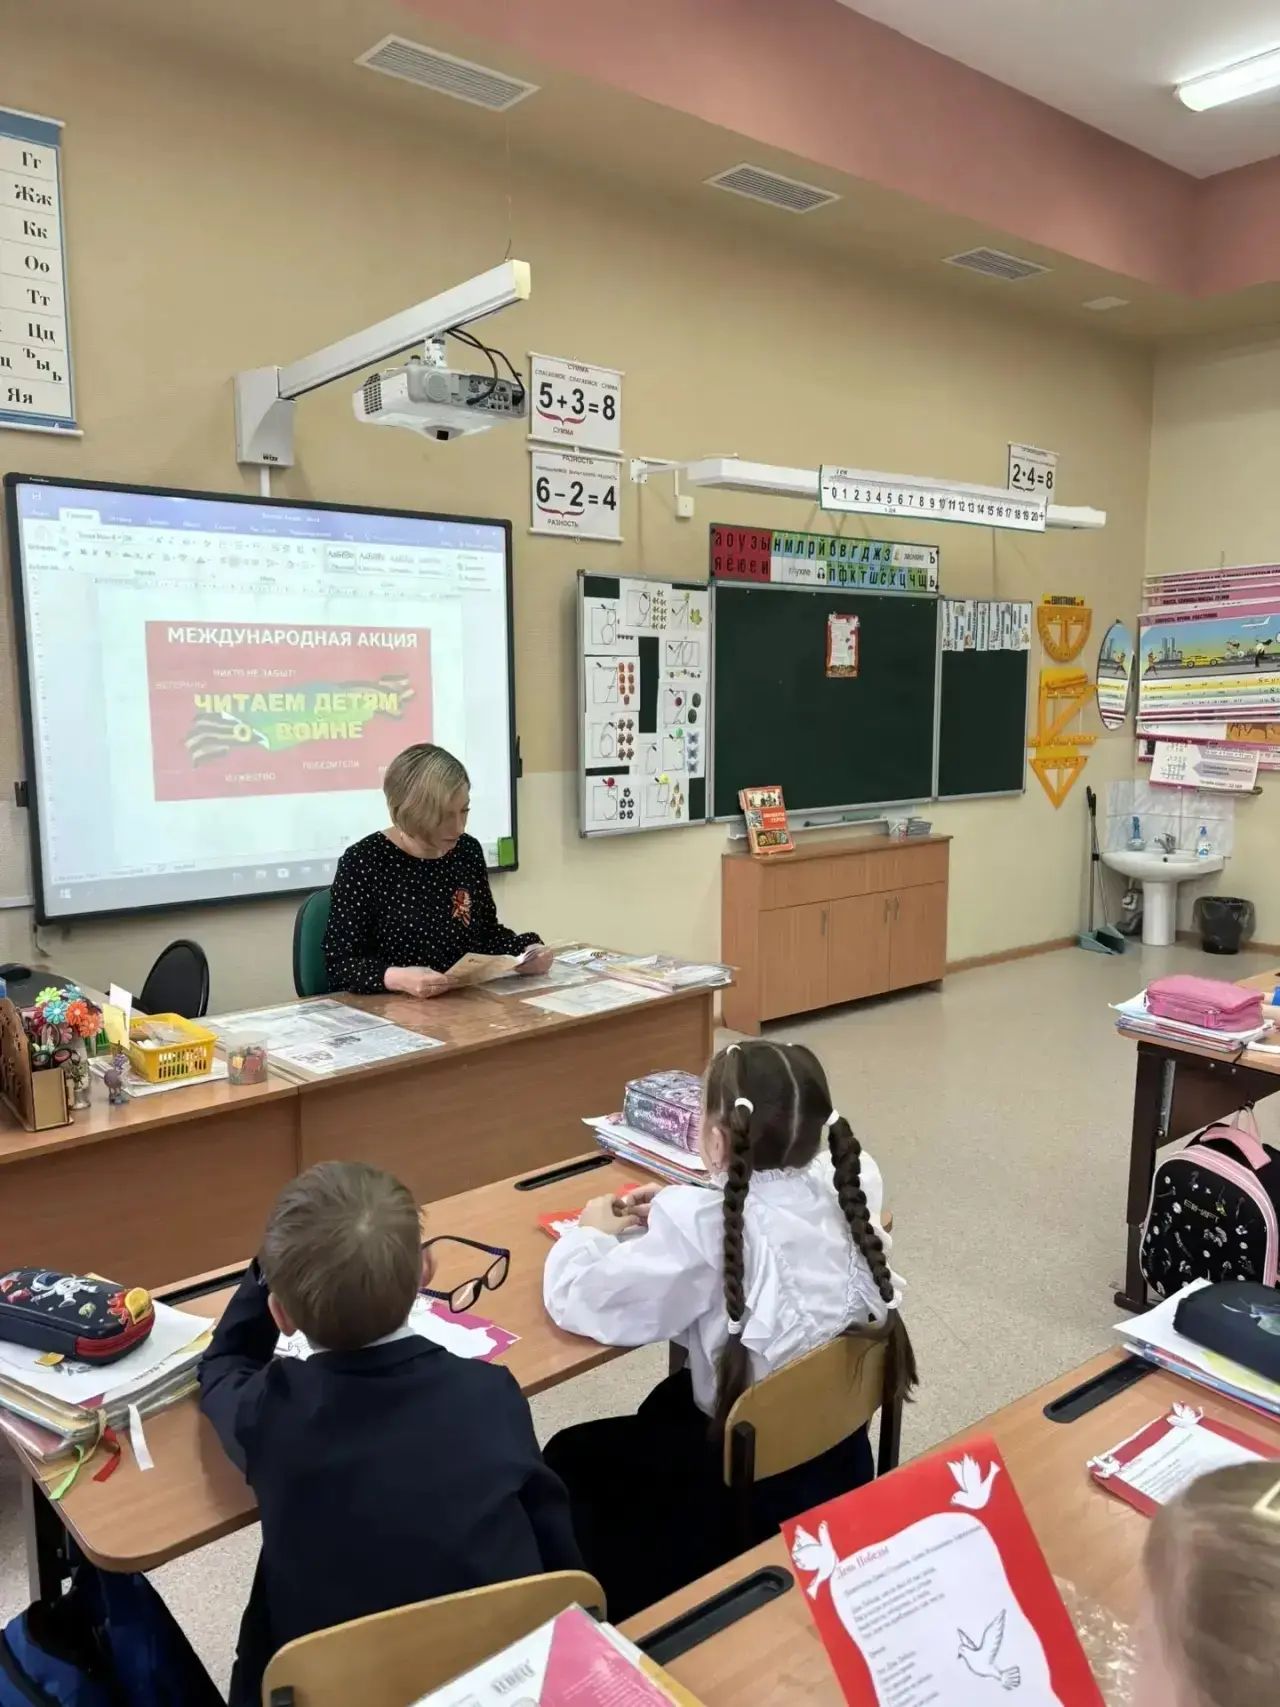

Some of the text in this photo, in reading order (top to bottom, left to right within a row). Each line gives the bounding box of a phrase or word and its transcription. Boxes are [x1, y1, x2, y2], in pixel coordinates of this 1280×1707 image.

[22, 151, 41, 169] Гг
[14, 184, 52, 206] Жж
[23, 220, 48, 239] Кк
[24, 255, 50, 273] Оо
[27, 288, 50, 308] Тт
[28, 323, 55, 344] Цц
[7, 387, 33, 404] Яя
[553, 426, 574, 436] СУММА
[854, 489, 860, 501] 2
[866, 490, 871, 502] 3
[876, 491, 881, 503] 4
[887, 493, 892, 504] 5
[898, 494, 903, 505] 6
[908, 495, 914, 506] 7
[919, 496, 925, 507] 8
[929, 497, 935, 508] 9
[939, 498, 946, 510] 10
[948, 499, 956, 510] 11
[958, 500, 965, 512] 12
[967, 501, 975, 513] 13
[977, 503, 984, 515] 14
[987, 505, 994, 516] 15
[996, 506, 1003, 518] 16
[1005, 508, 1012, 519] 17
[547, 518, 579, 528] РАЗНОСТЬ
[167, 627, 418, 649] МЕЖДУНАРОДНАЯ АКЦИЯ
[213, 668, 244, 677] НИКТО
[247, 668, 258, 677] НЕ
[194, 692, 400, 714] ЧИТАЕМ ДЕТЯМ
[232, 717, 363, 742] О ВОЙНЕ
